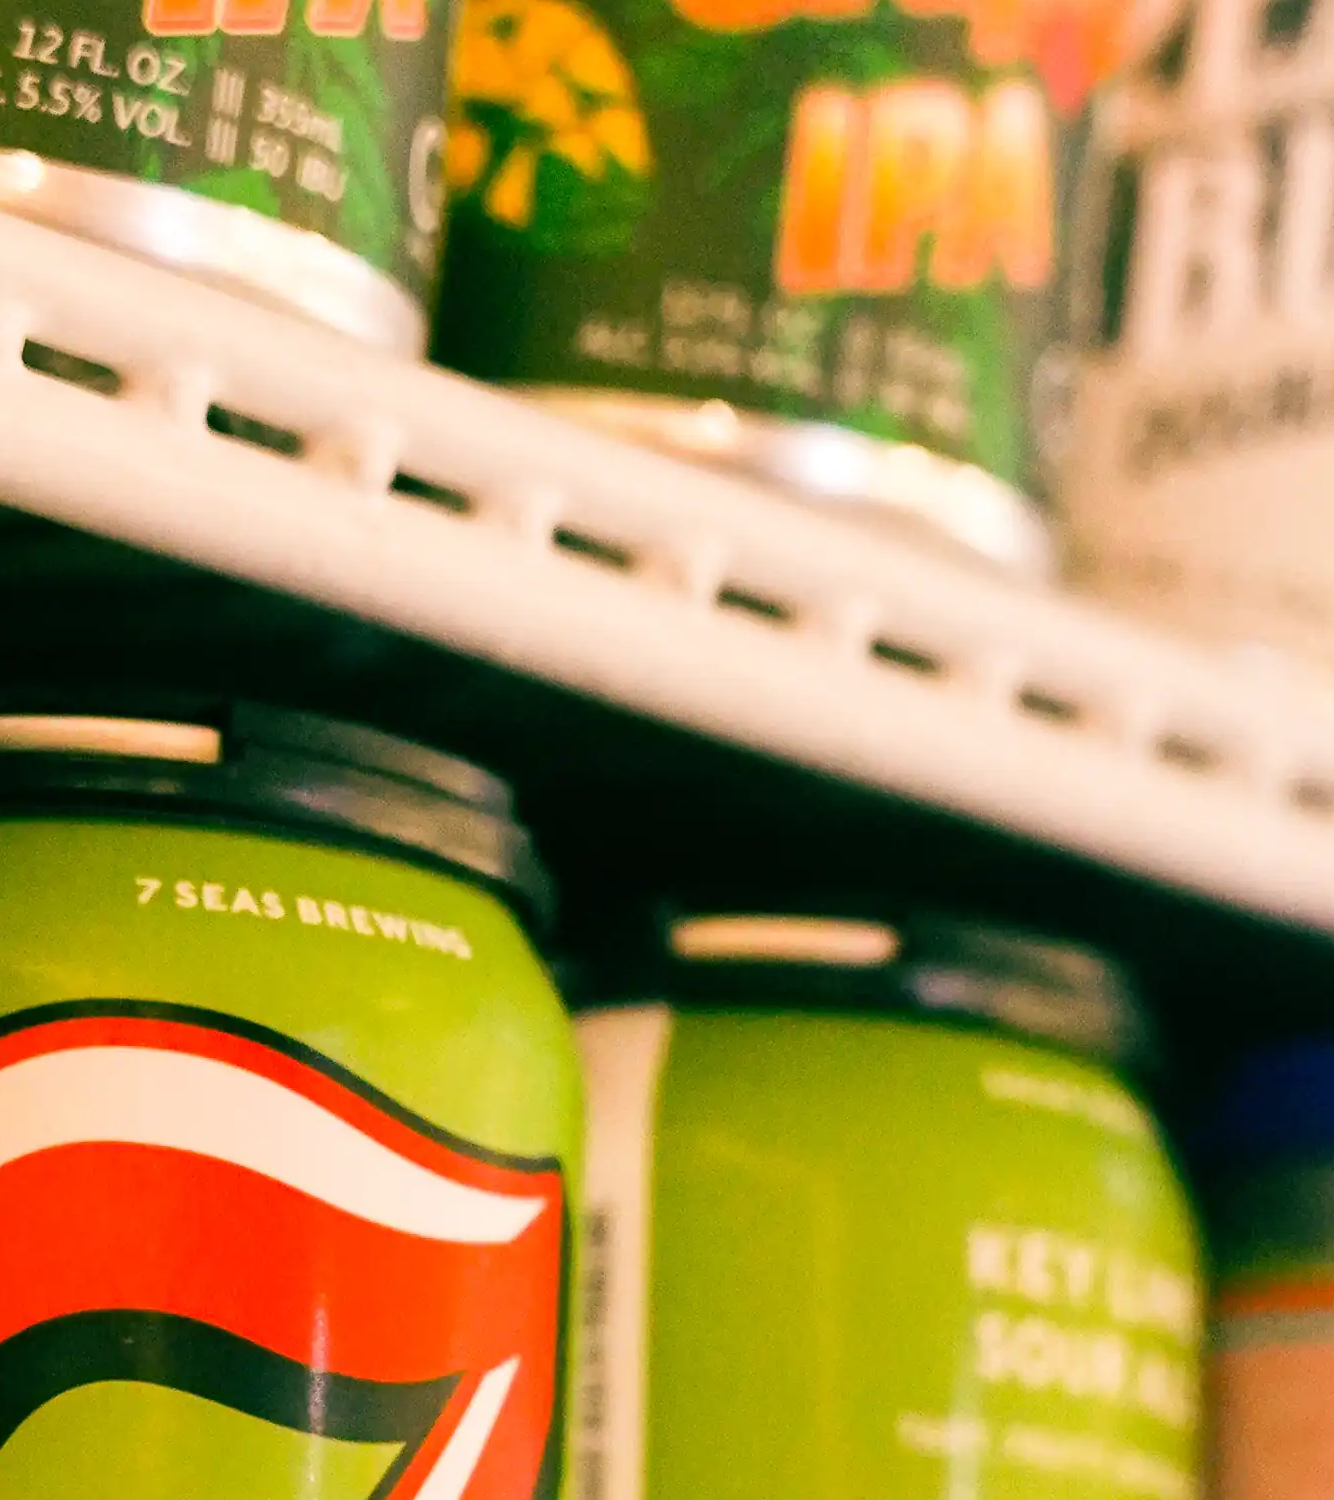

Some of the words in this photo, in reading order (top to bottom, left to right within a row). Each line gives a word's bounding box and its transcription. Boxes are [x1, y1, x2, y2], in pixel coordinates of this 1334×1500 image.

[13, 19, 64, 66] 12
[13, 74, 104, 124] 5.5%
[134, 876, 163, 906] 7
[175, 882, 287, 922] SEAS
[296, 895, 473, 961] BREWING
